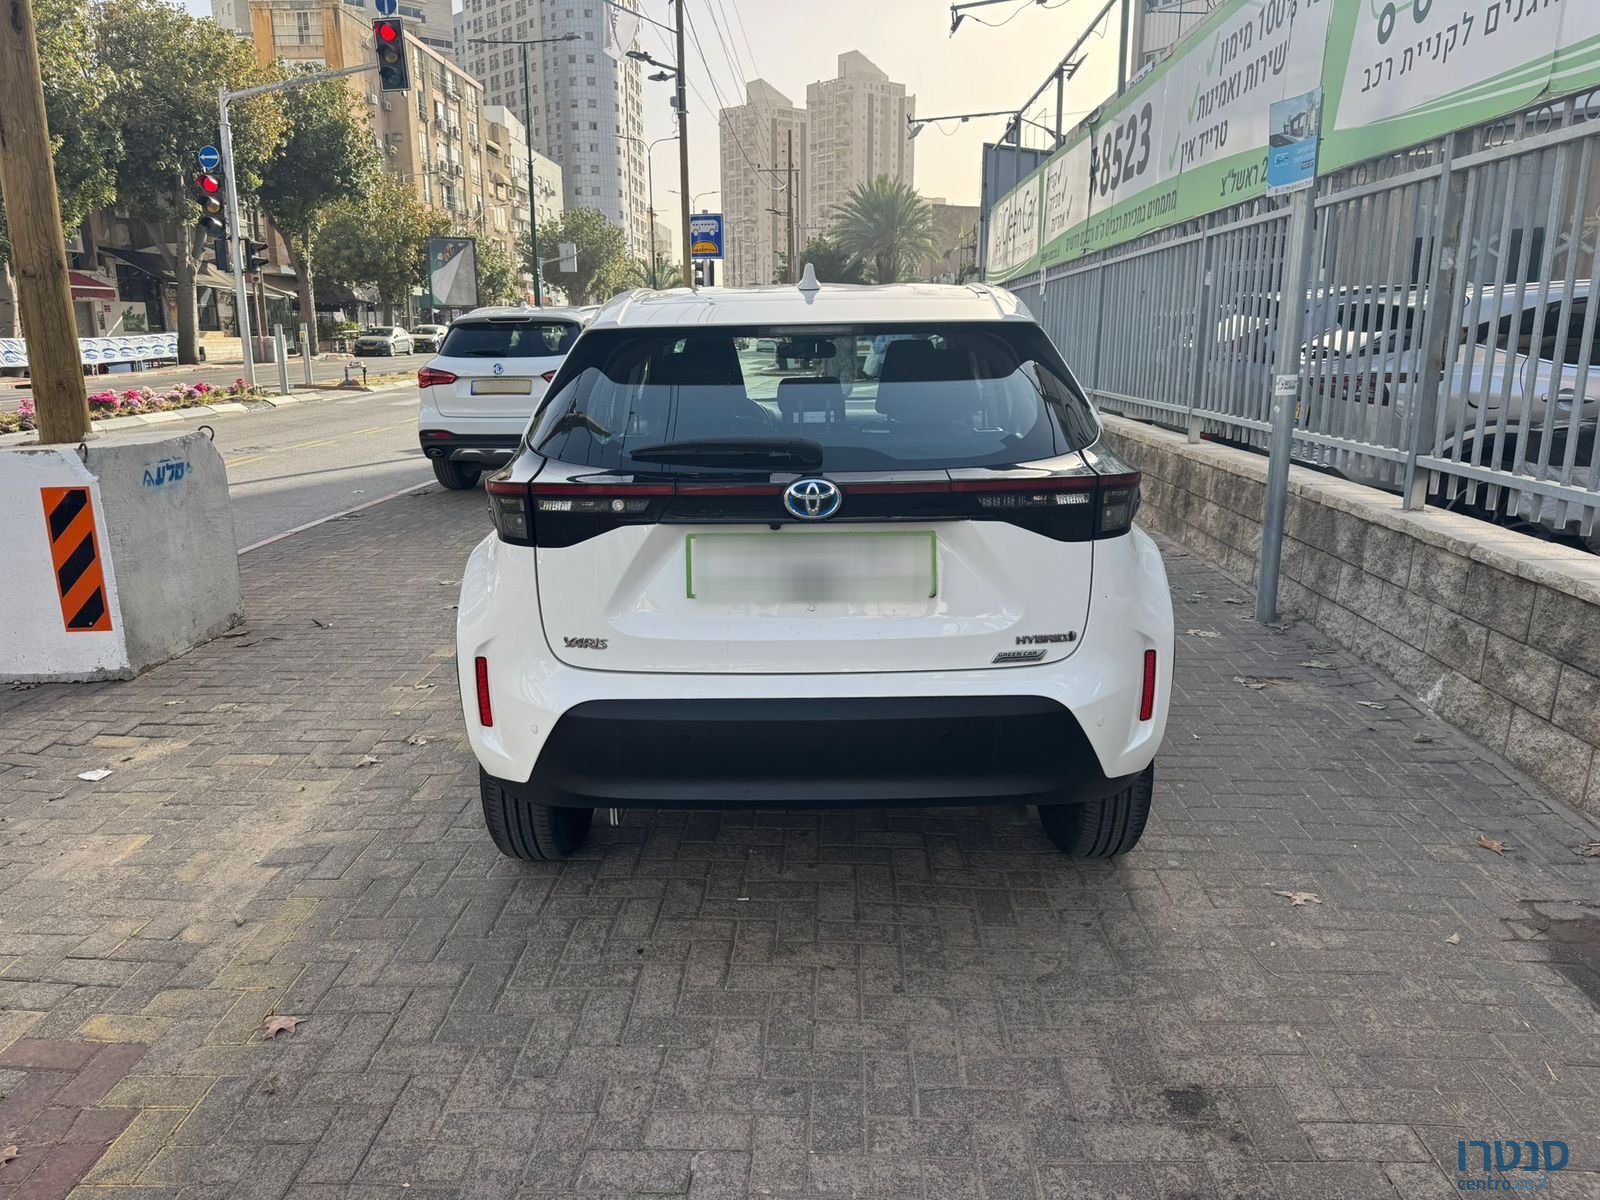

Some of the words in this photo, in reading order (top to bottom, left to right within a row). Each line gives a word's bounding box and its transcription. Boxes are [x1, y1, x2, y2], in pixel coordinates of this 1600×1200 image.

[1219, 21, 1253, 76] מימון
[1243, 40, 1287, 94] שירות
[1400, 11, 1474, 75] לקניית
[1197, 71, 1241, 122] ואמינות
[1361, 57, 1393, 93] רכב
[1199, 119, 1228, 157] טרייד
[563, 636, 608, 650] YARIS
